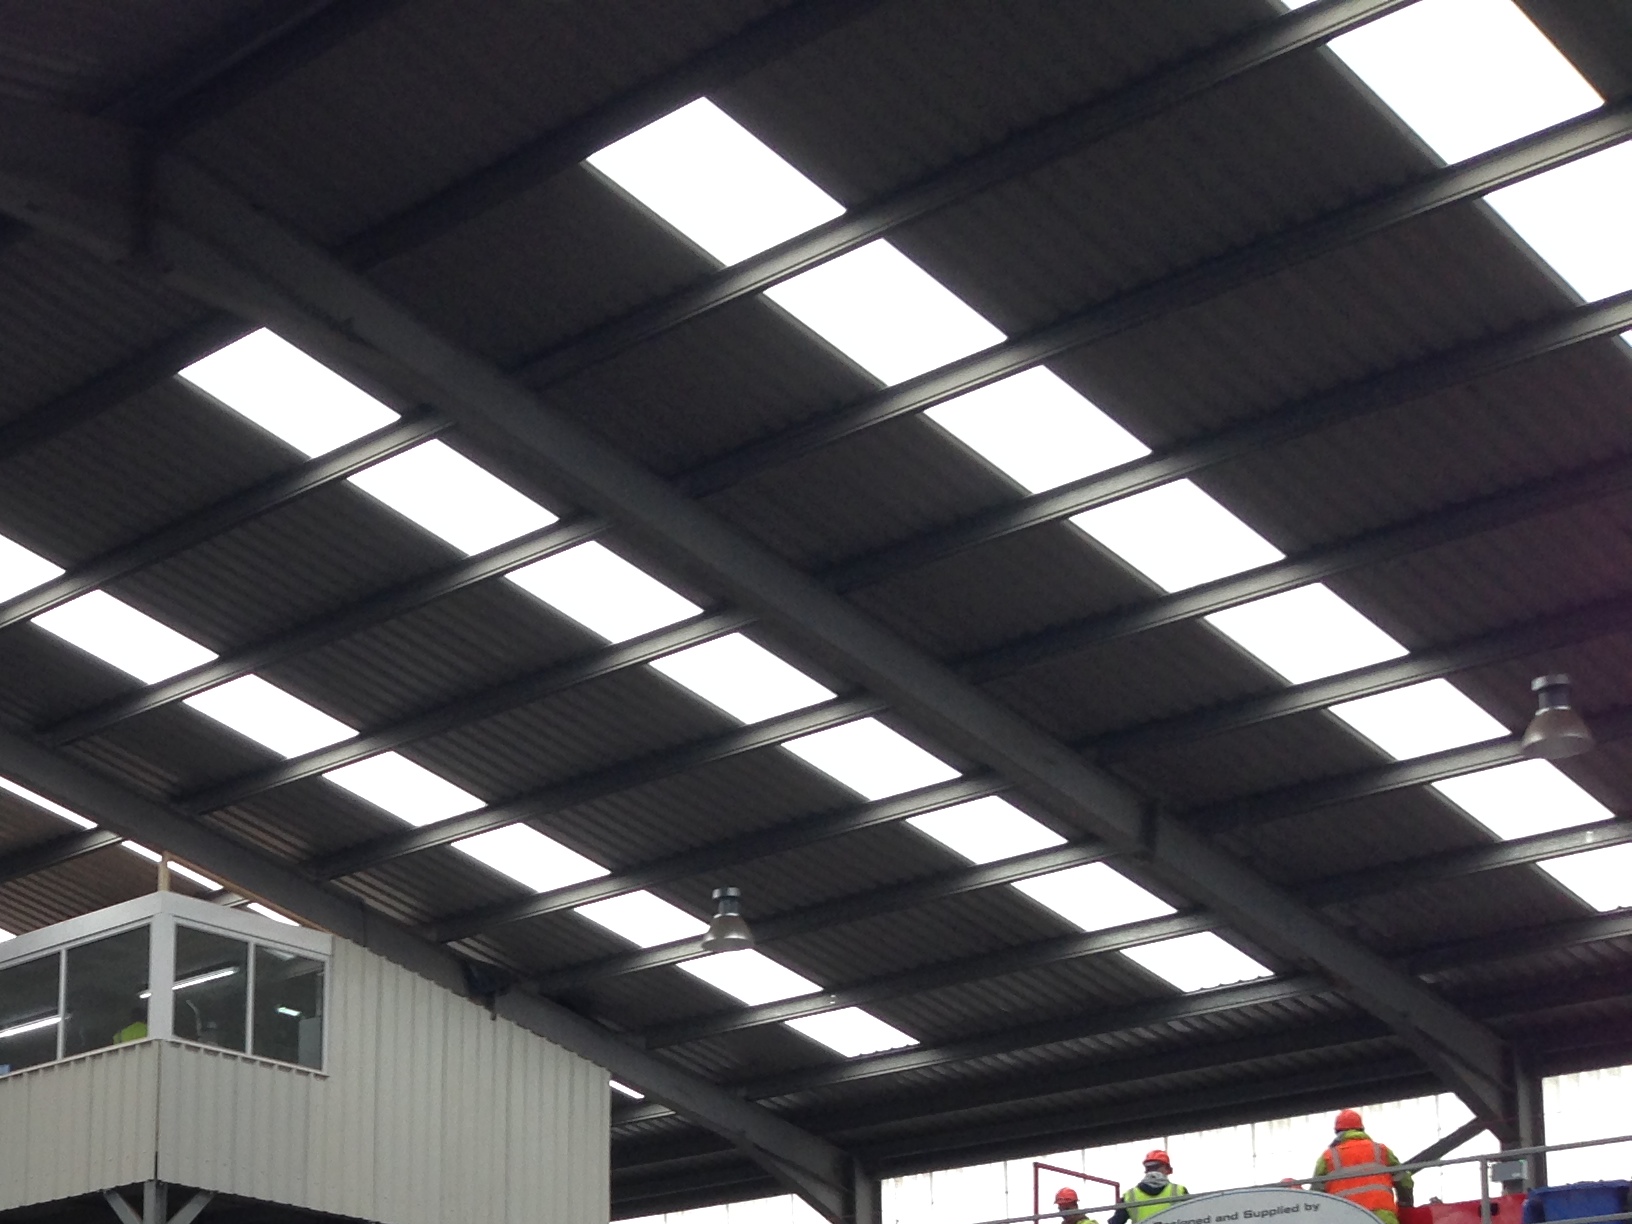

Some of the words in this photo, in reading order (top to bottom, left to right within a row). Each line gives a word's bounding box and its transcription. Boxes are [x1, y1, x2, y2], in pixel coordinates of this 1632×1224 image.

[1215, 1212, 1239, 1223] and
[1243, 1205, 1300, 1220] Supplied
[1304, 1202, 1321, 1213] by
